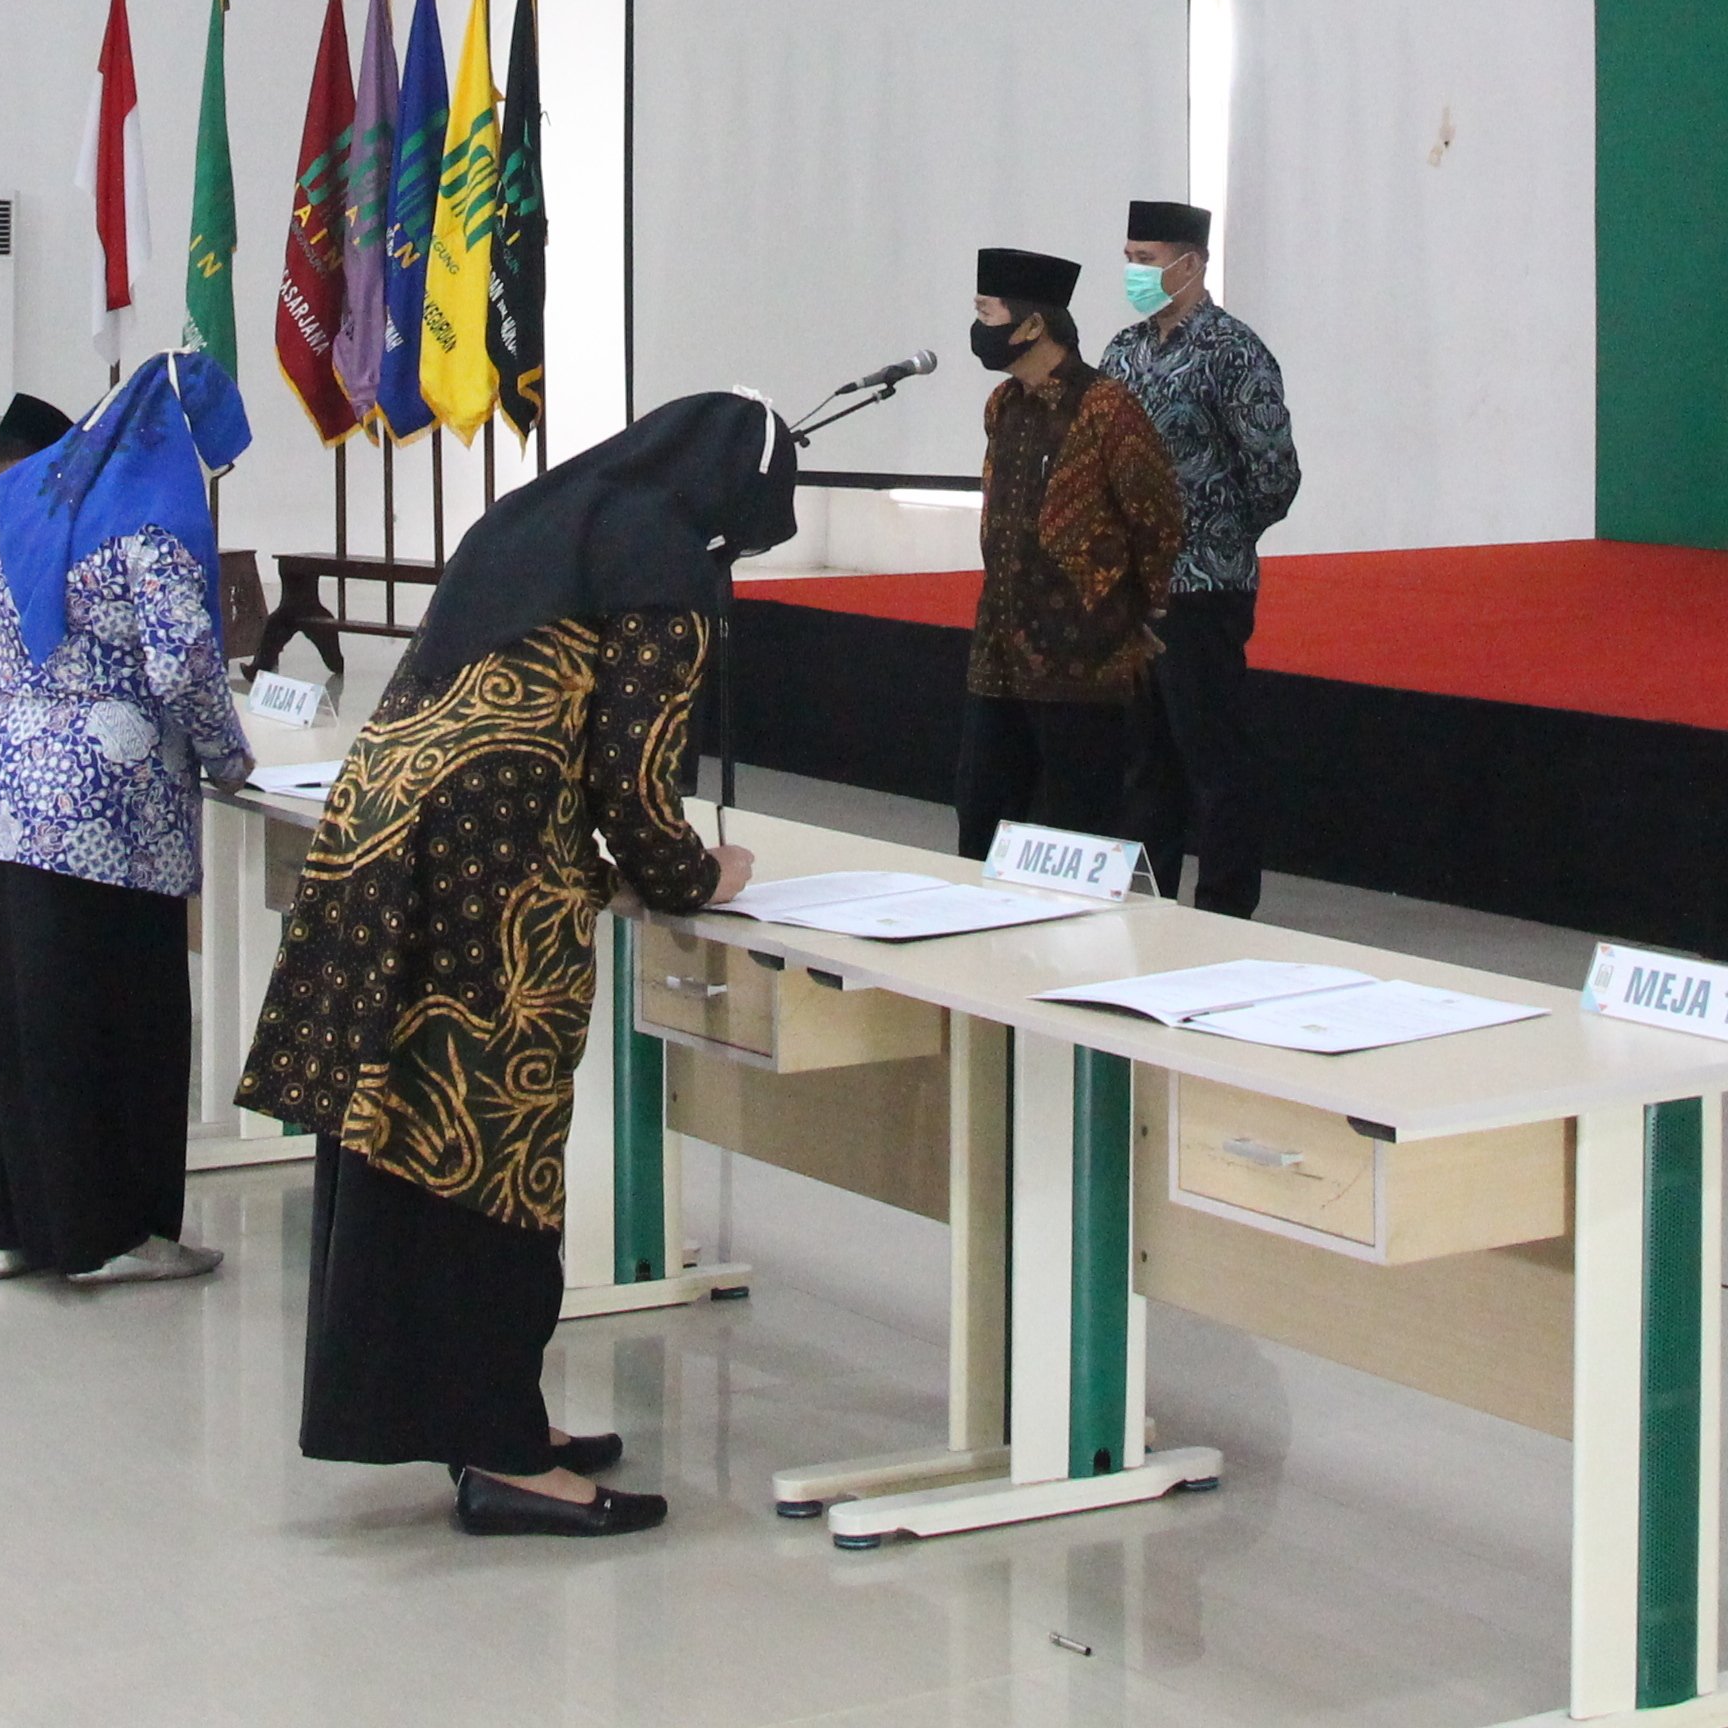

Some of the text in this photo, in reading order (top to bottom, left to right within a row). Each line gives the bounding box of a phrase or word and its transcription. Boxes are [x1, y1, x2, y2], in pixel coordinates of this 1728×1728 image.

[431, 235, 461, 276] GUNG
[260, 683, 308, 715] MEJA 4
[1016, 839, 1108, 884] MEJA 2
[1622, 965, 1712, 1019] MEJA
